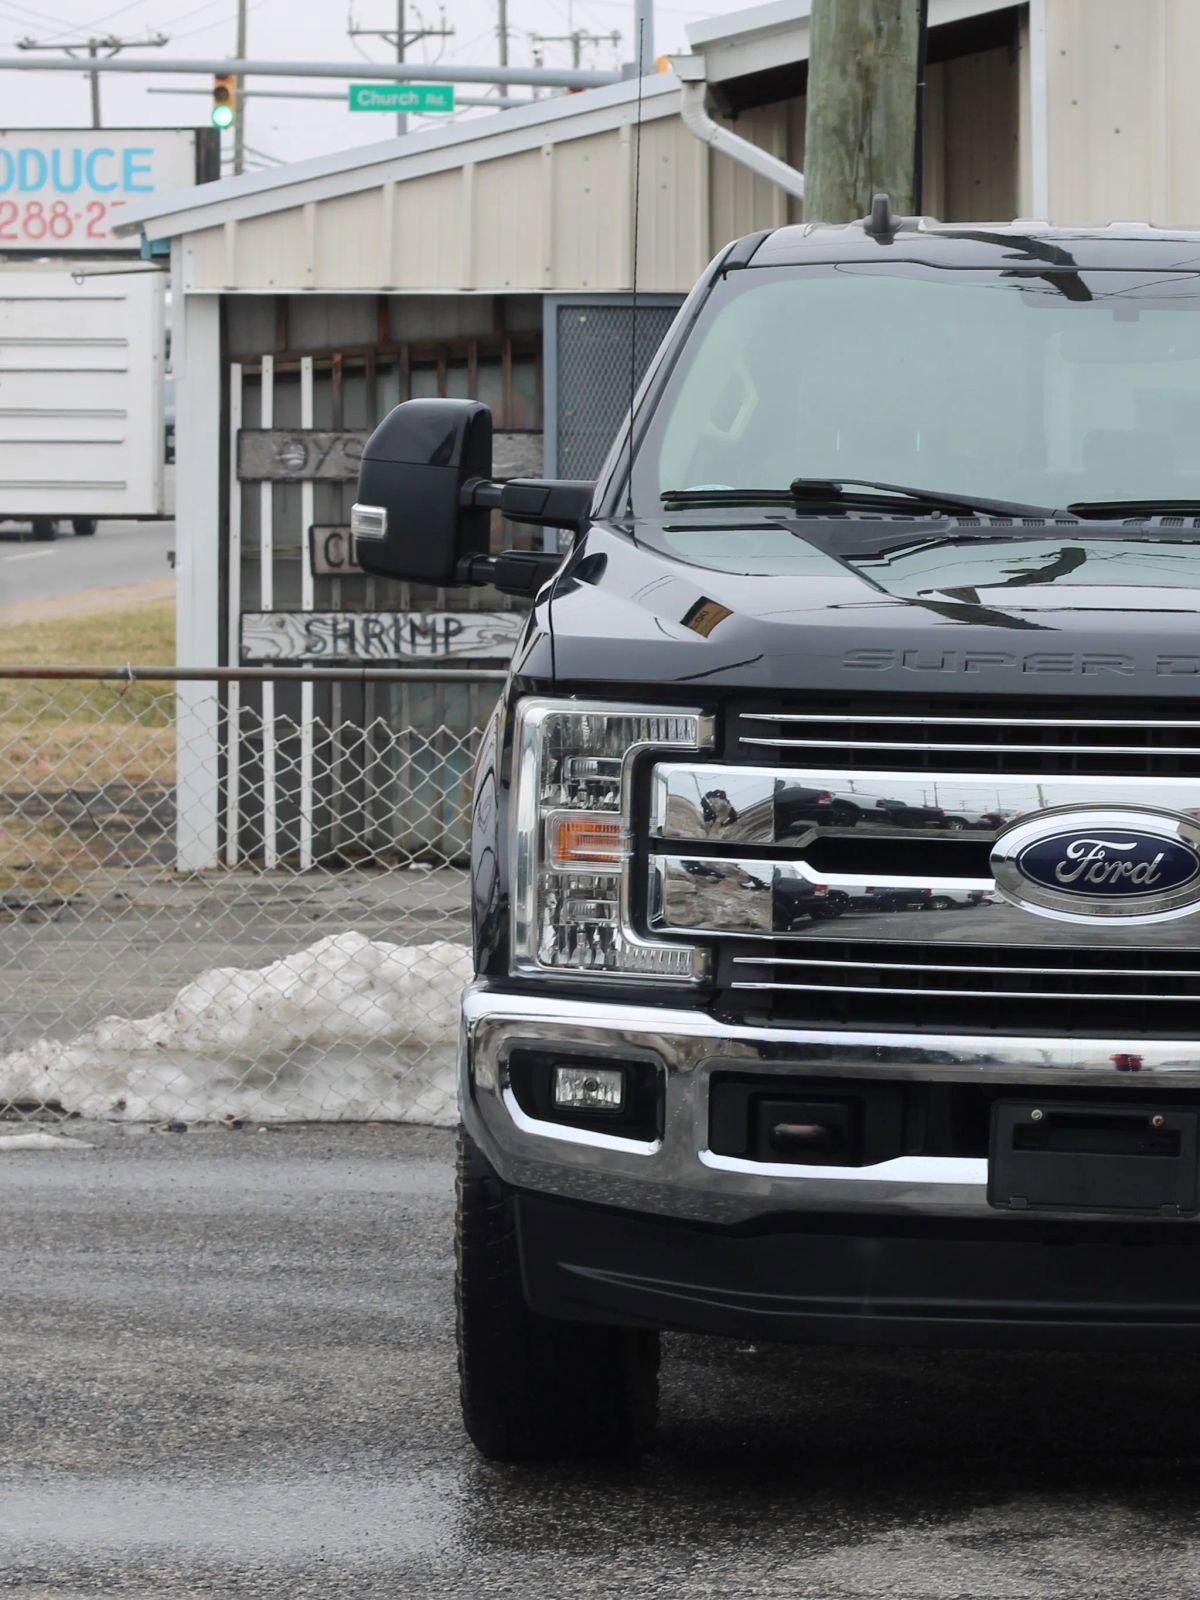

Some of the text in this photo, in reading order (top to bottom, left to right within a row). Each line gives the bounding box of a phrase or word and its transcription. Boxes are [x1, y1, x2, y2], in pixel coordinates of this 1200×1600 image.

[357, 89, 419, 106] Church
[281, 436, 362, 474] OYS
[305, 617, 463, 655] SHRIMP
[841, 648, 1136, 678] SUPER
[1055, 839, 1165, 884] Ford
